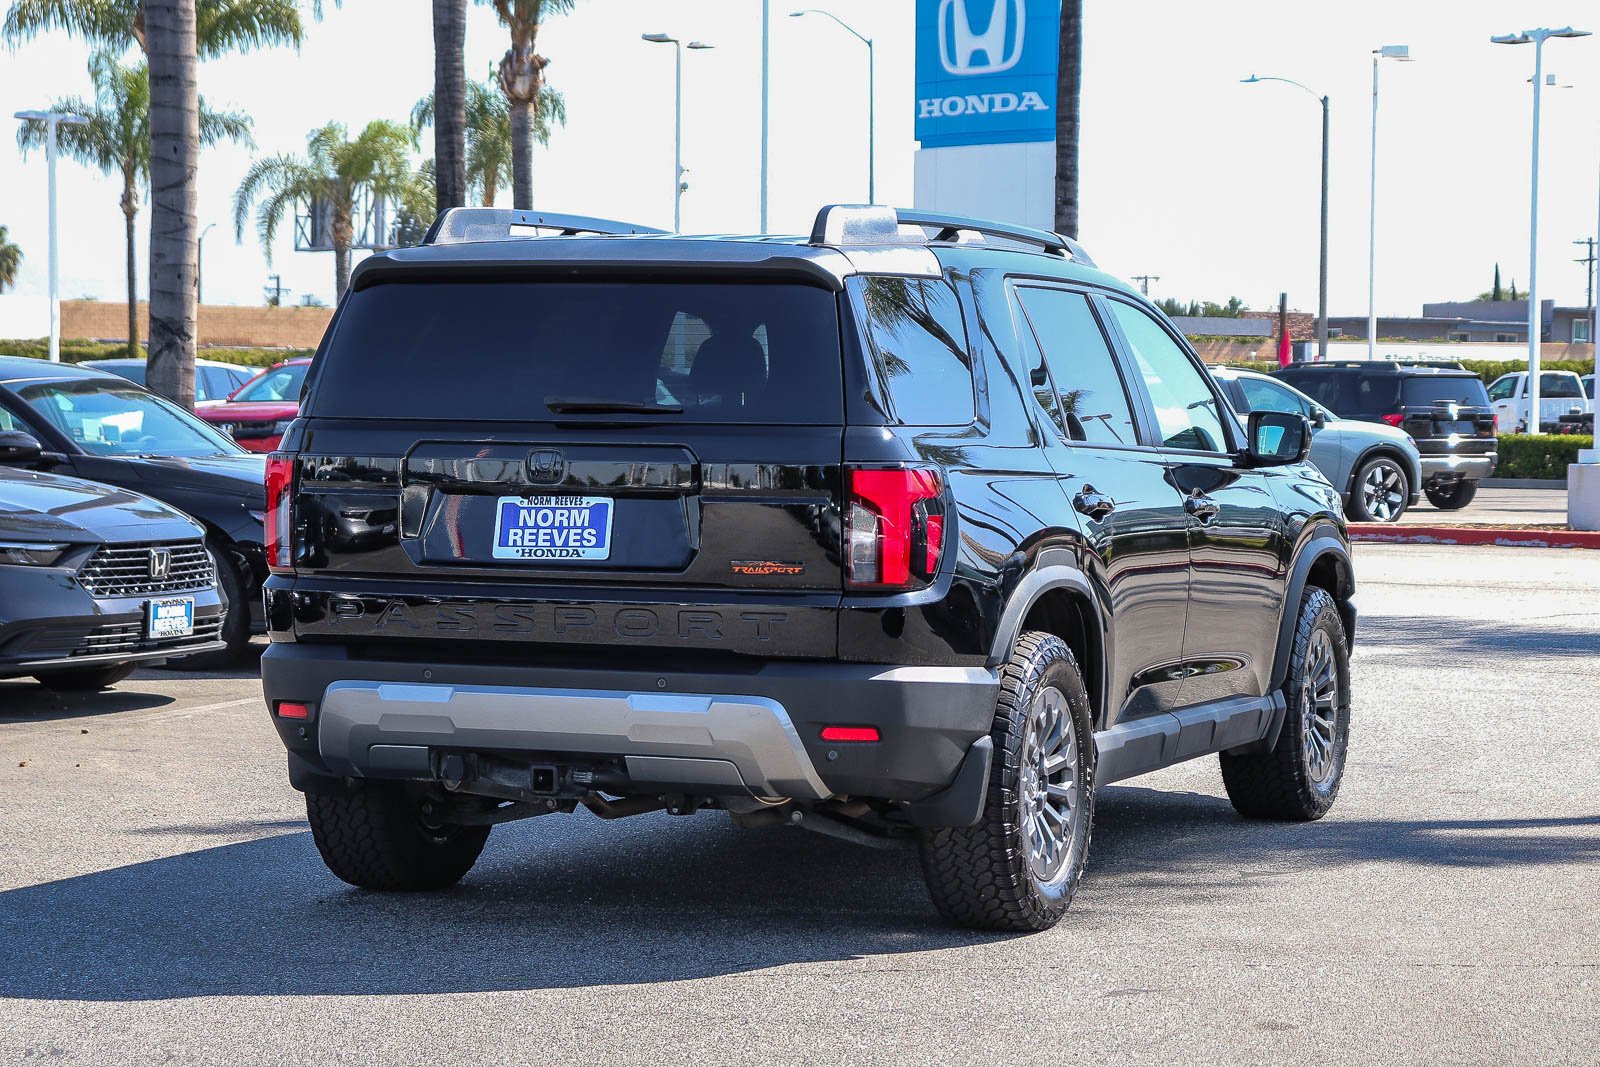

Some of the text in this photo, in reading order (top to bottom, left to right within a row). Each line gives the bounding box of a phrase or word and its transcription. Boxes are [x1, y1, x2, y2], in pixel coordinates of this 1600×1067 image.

[918, 91, 1050, 119] HONDA
[527, 496, 584, 507] NORM REEVES
[518, 508, 590, 527] NORM
[508, 528, 597, 547] REEVES
[520, 548, 583, 558] HONDA
[731, 566, 803, 575] TRAILSPORT
[326, 597, 788, 641] PASSPORT
